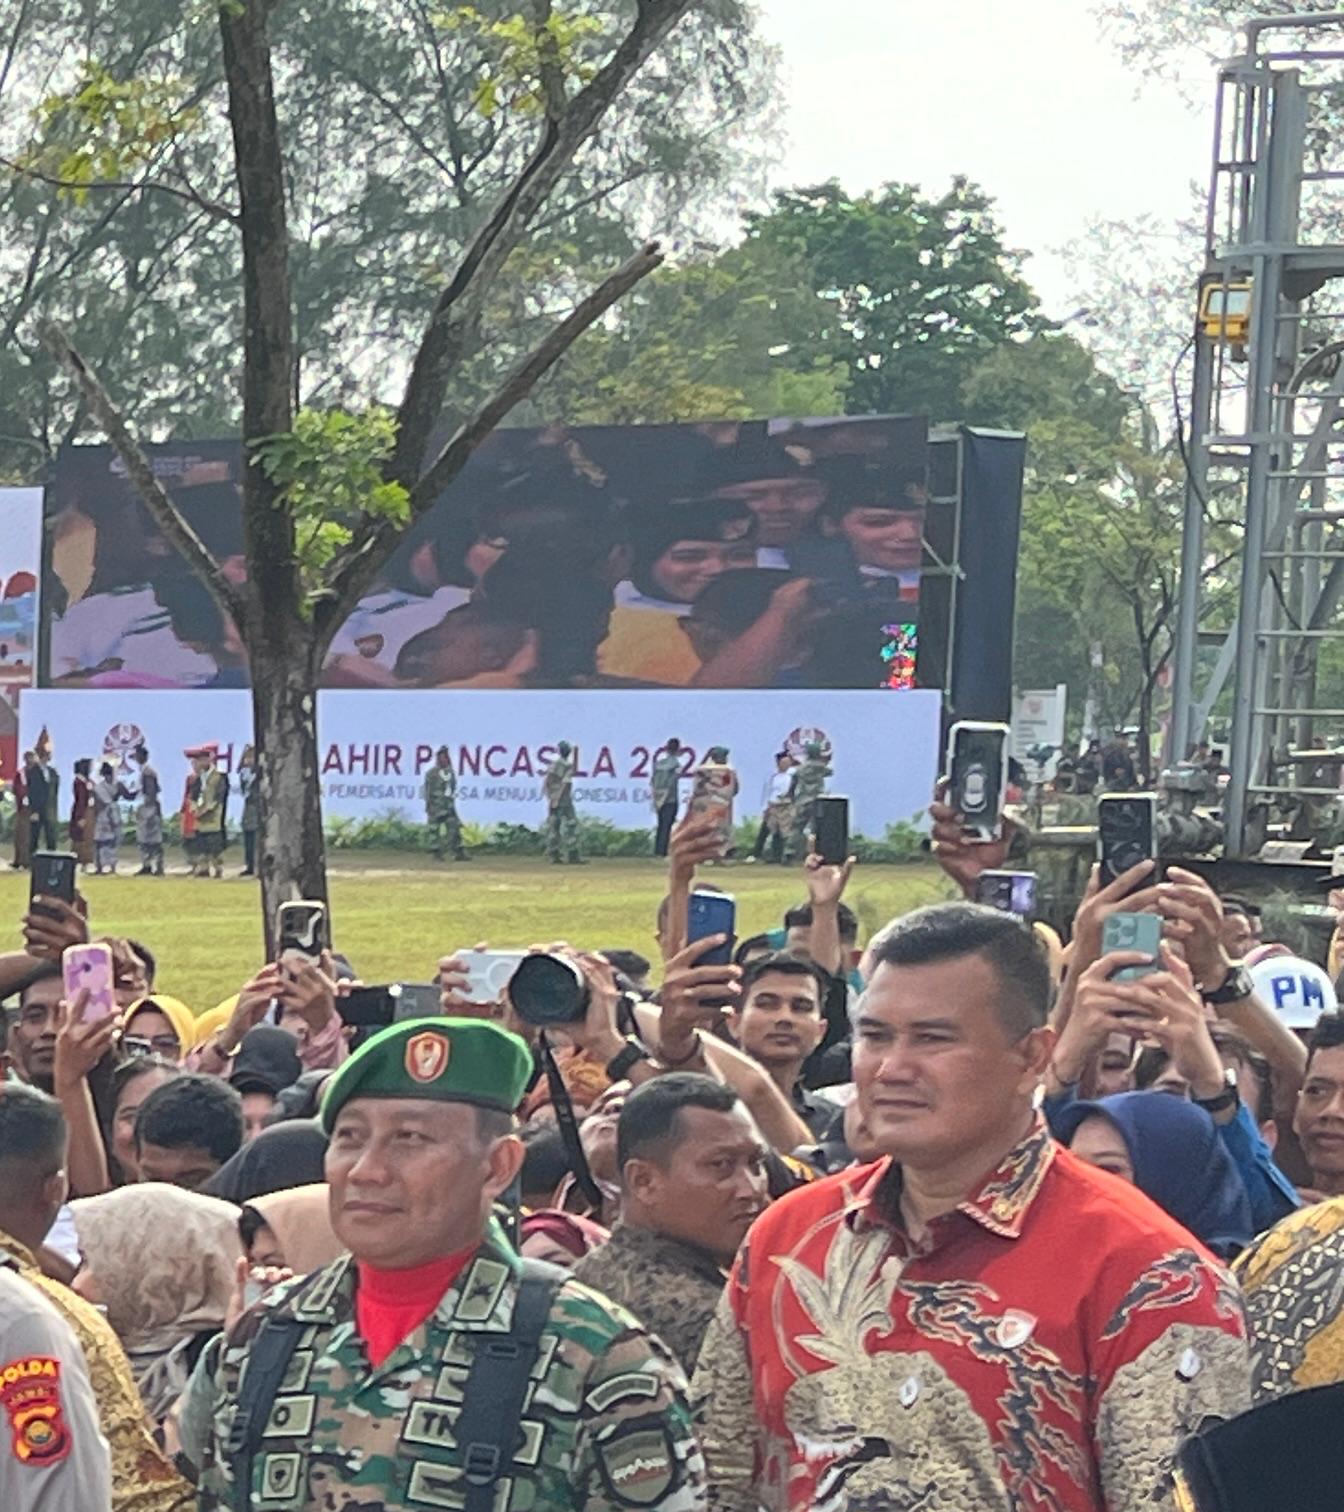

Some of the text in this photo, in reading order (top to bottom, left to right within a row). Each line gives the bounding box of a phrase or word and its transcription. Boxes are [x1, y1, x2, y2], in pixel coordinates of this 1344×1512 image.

[322, 743, 402, 776] AHIR
[414, 743, 616, 778] PNCASLA
[1271, 975, 1325, 1009] PM
